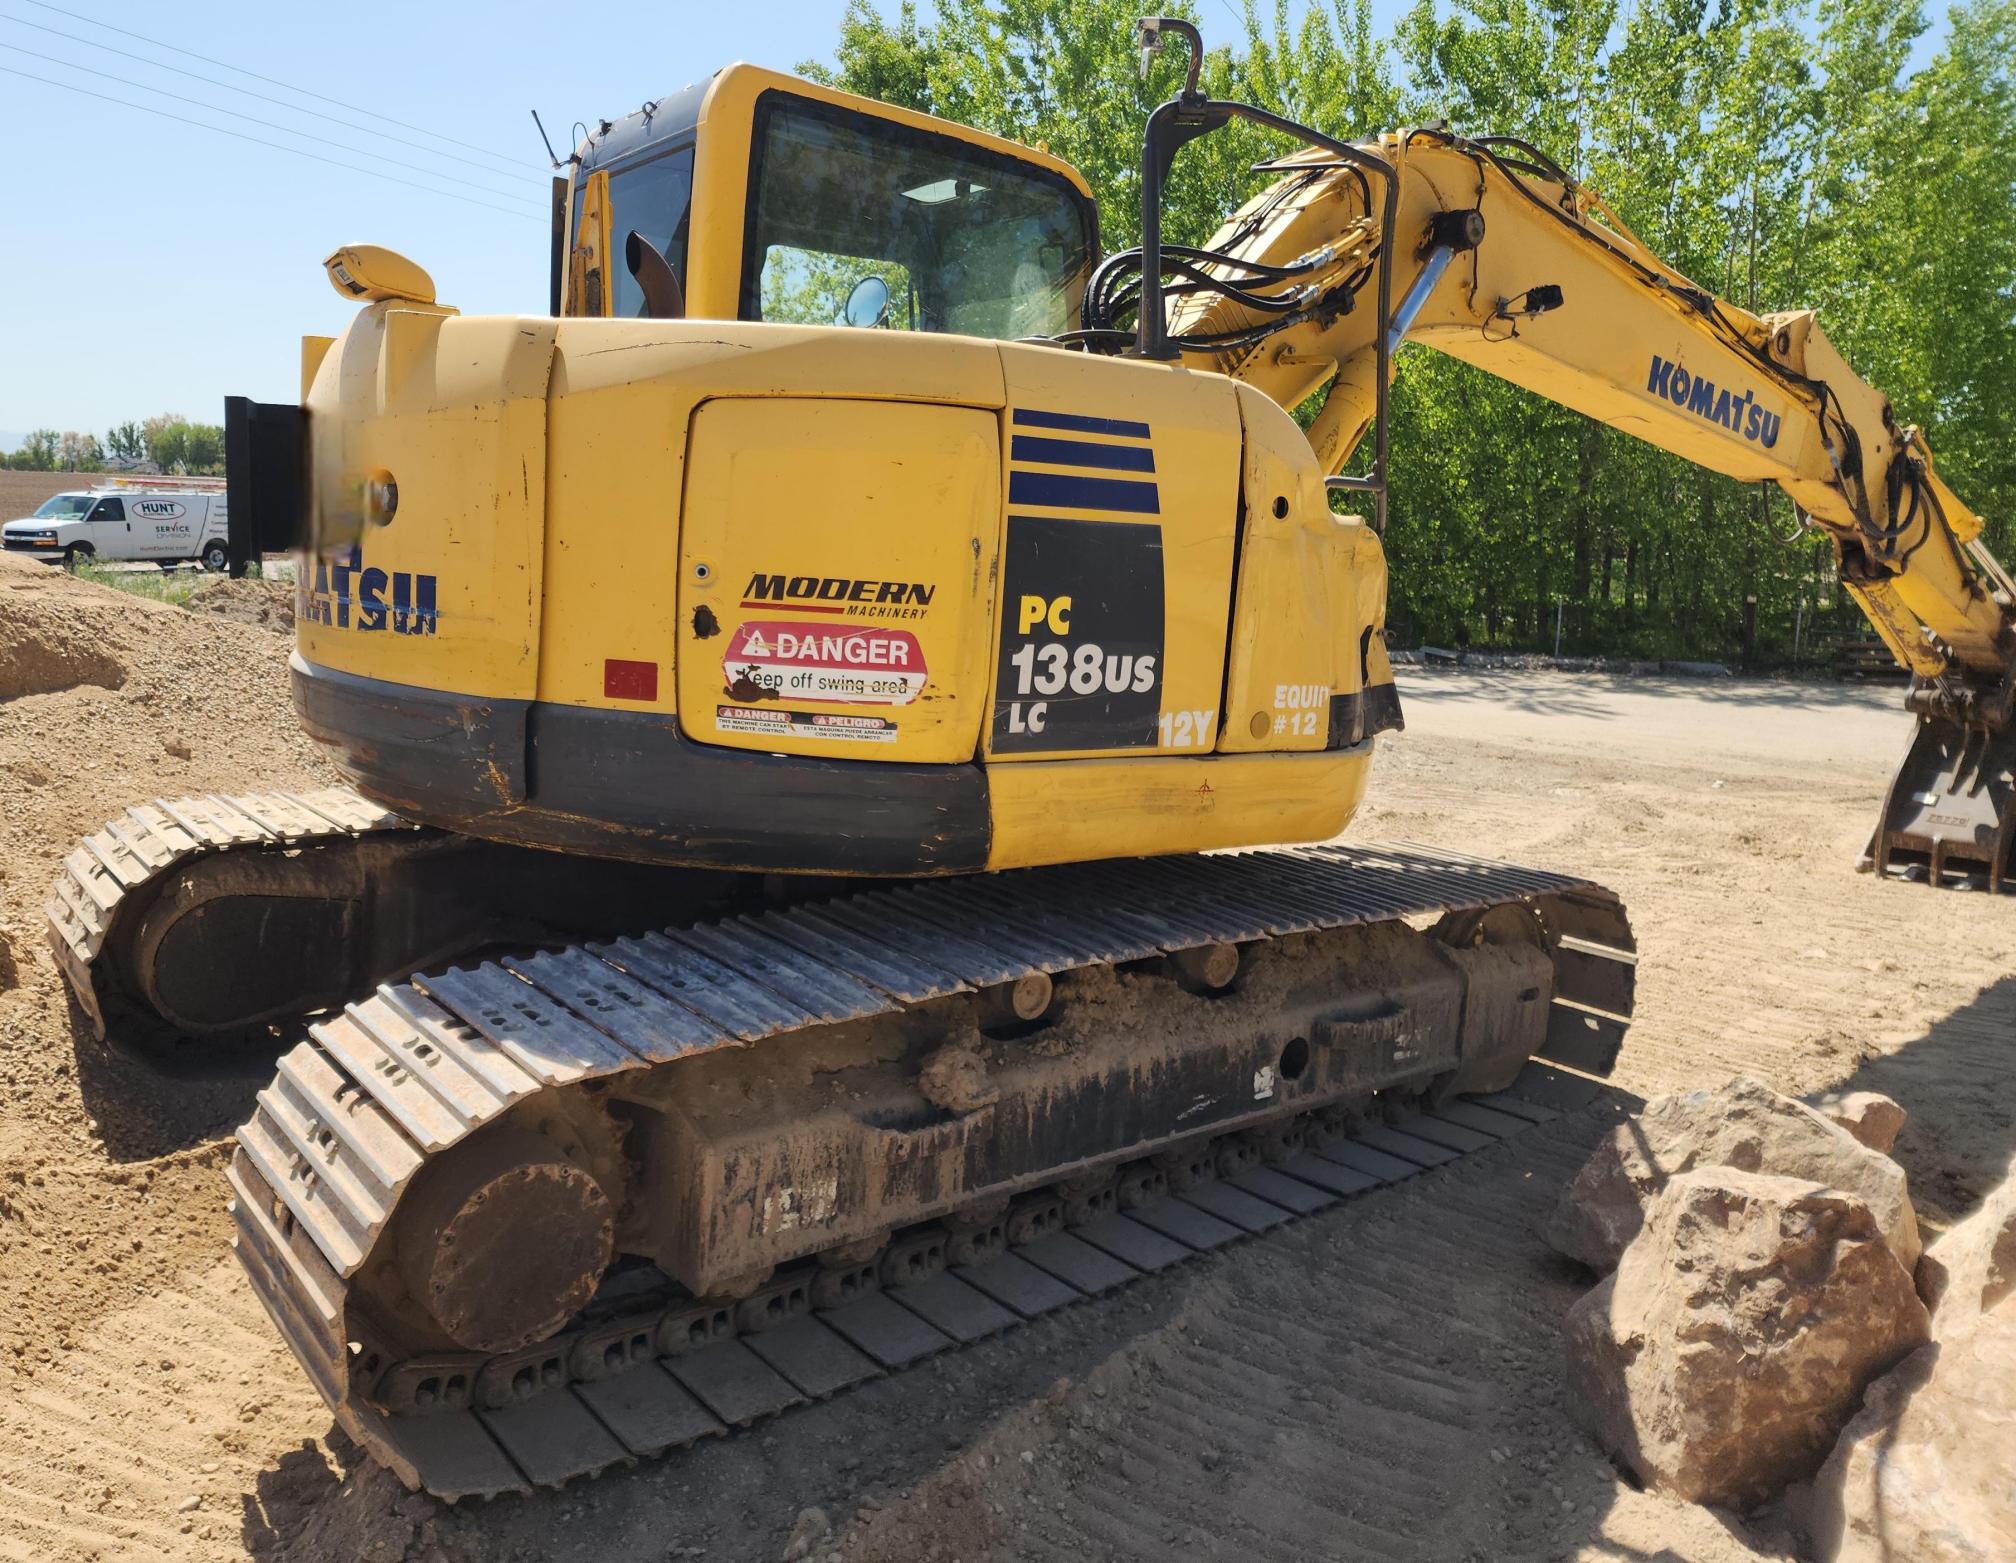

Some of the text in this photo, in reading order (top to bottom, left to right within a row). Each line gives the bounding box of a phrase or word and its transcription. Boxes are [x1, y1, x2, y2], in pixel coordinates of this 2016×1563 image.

[1647, 355, 1781, 449] KOMATSU
[141, 503, 175, 513] HUNT
[155, 523, 190, 533] SERVICE
[743, 573, 936, 606] MODERN
[846, 605, 928, 620] MACHINERY
[1018, 595, 1072, 635] PC
[777, 633, 909, 665] DANGER
[790, 672, 813, 689] off
[818, 675, 864, 694] swing
[735, 709, 786, 722] DANGER
[828, 716, 880, 728] PELIGRO
[1008, 702, 1048, 734] LC
[1158, 709, 1214, 748] 12Y
